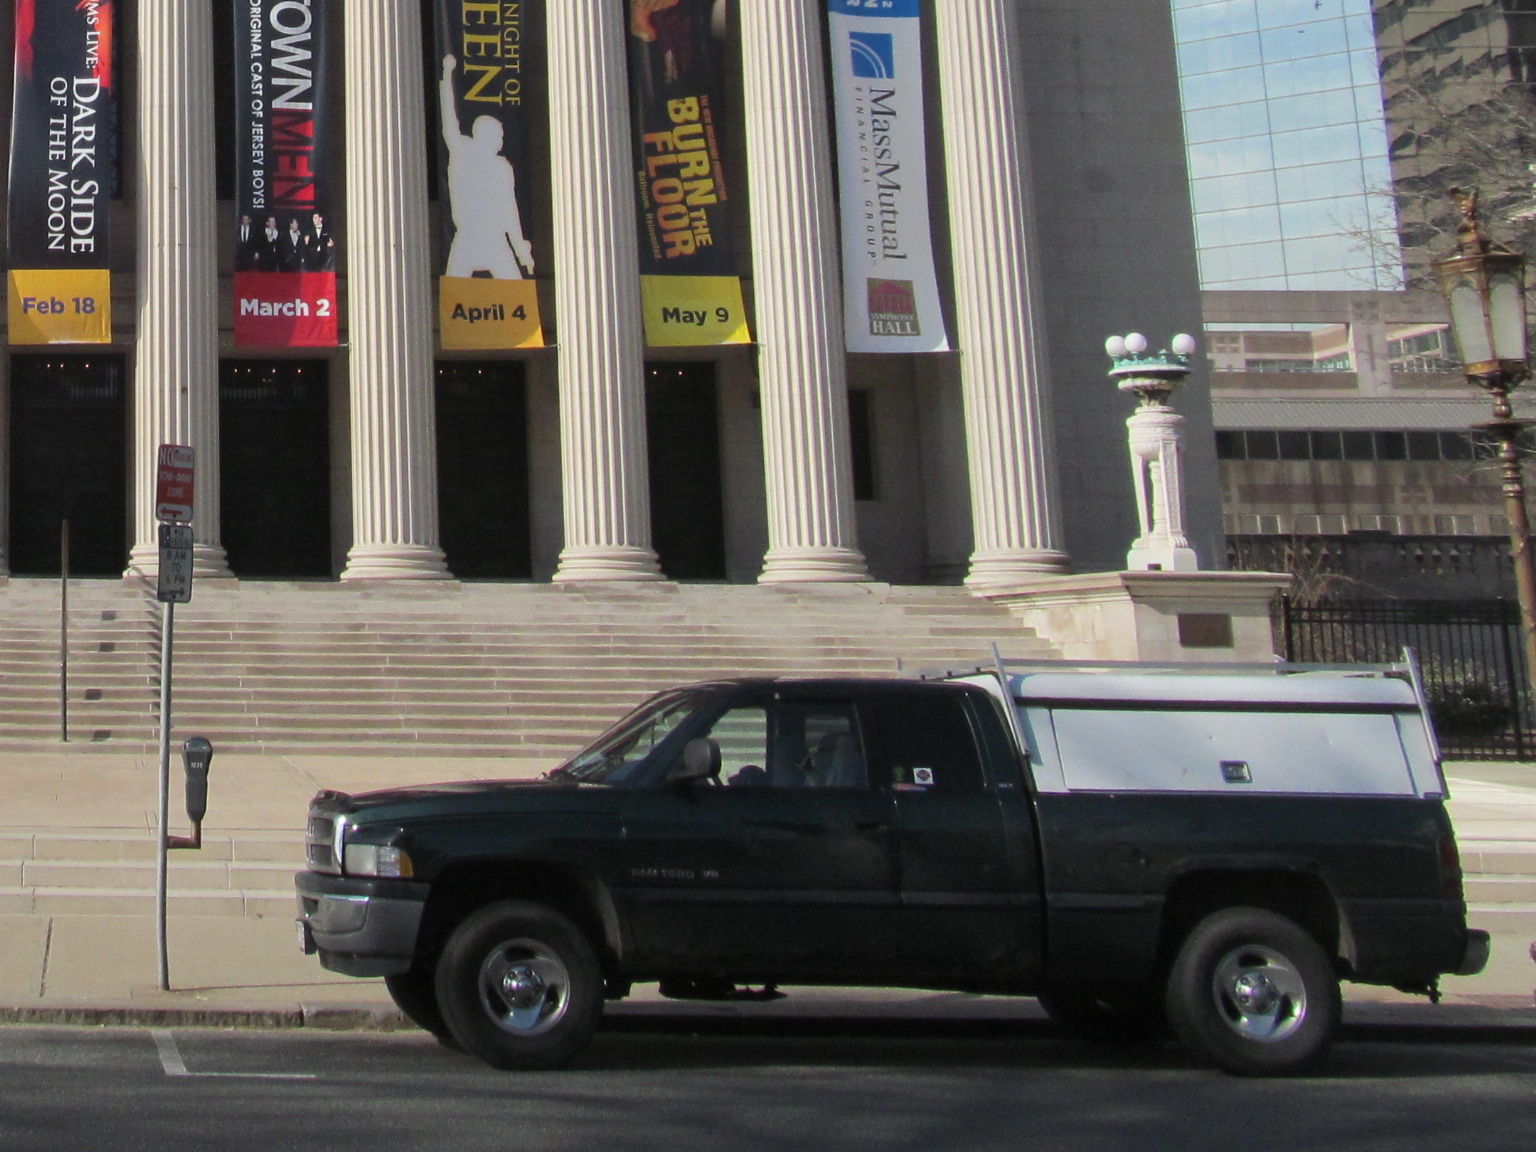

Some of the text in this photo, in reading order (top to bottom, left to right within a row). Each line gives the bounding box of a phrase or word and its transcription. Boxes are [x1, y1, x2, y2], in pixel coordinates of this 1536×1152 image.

[85, 30, 101, 69] LIVE:
[503, 3, 520, 73] NIGHT
[250, 62, 263, 96] CAST
[504, 79, 521, 105] OF
[251, 99, 263, 118] OF
[252, 121, 264, 165] JERSEY
[272, 110, 315, 209] MEN
[47, 76, 68, 250] OF THE MOON
[70, 75, 101, 254] DARK SIDE
[666, 96, 718, 247] BURN THE
[855, 87, 876, 258] FINANCIAL GROUP
[869, 87, 907, 261] MassMutual
[252, 169, 264, 209] BOYS!
[642, 131, 696, 258] FLOOR
[22, 297, 96, 314] Feb 18
[240, 299, 330, 316] March 2
[451, 303, 527, 324] April 4
[662, 307, 729, 326] May 9
[872, 320, 917, 334] HALL
[159, 447, 173, 466] NO
